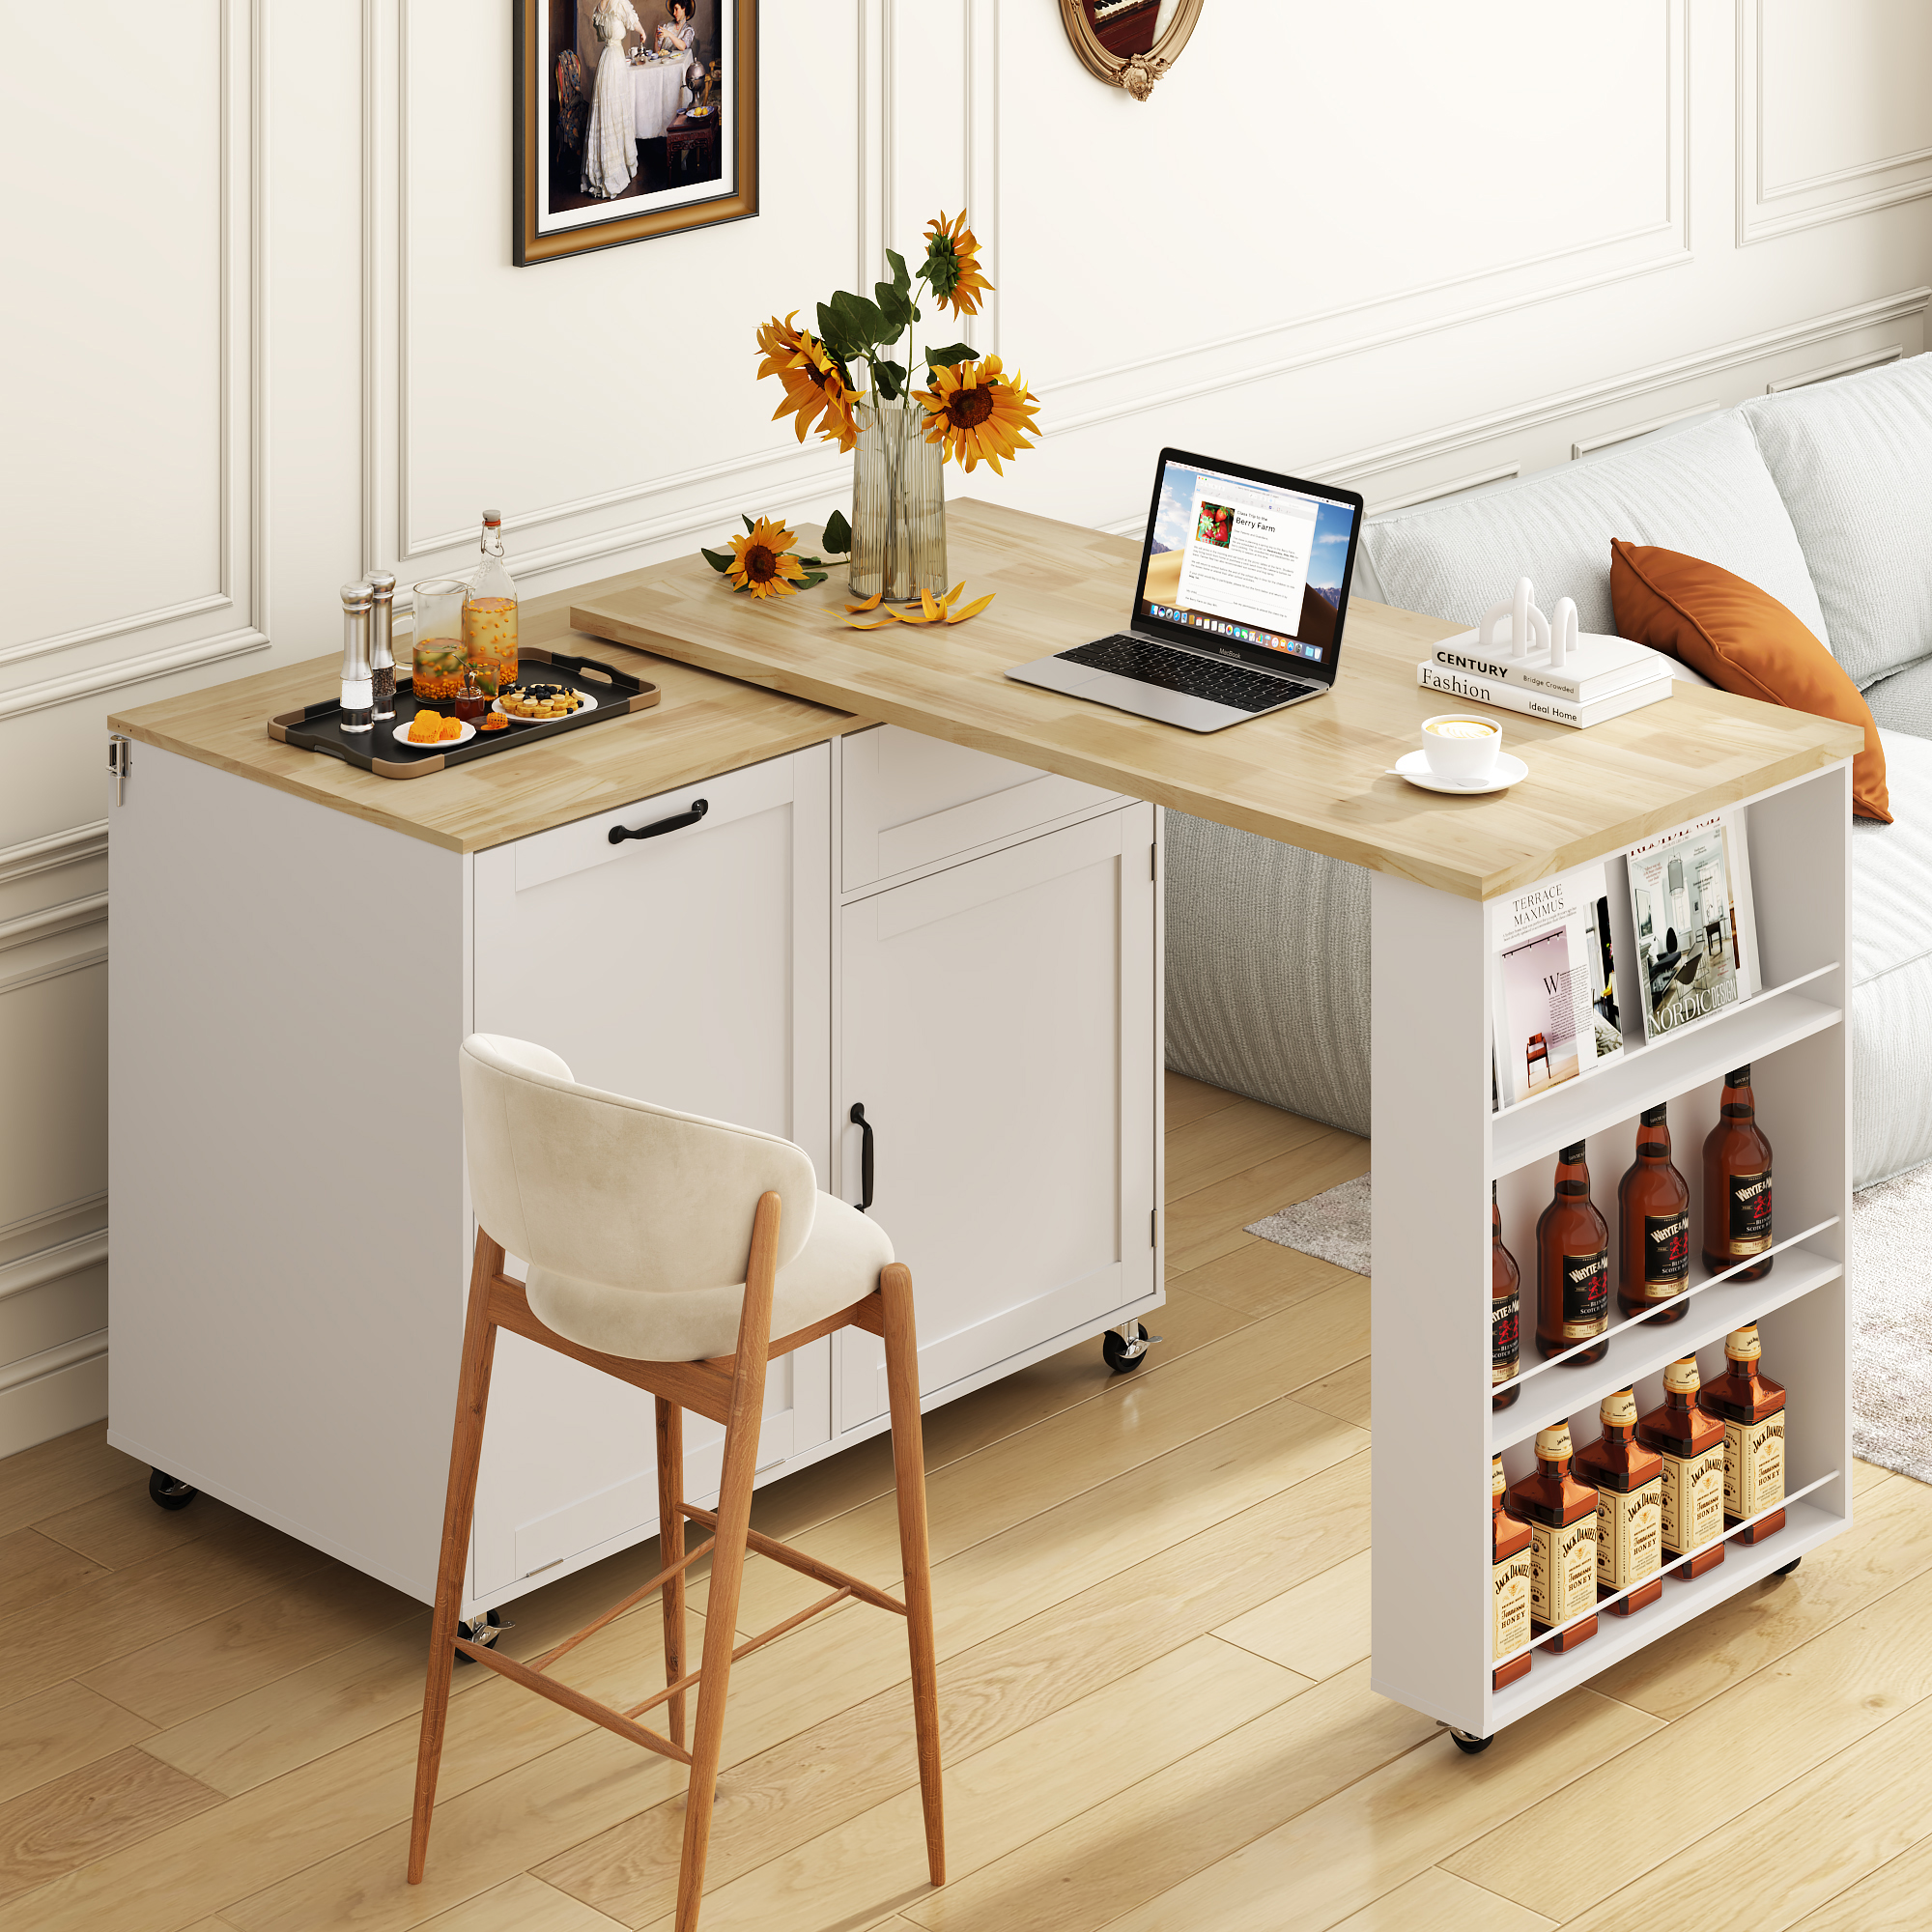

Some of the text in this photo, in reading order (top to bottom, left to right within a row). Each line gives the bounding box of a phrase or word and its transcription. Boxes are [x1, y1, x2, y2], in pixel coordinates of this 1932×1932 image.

[1236, 517, 1275, 533] Berry Farm
[1219, 647, 1240, 659] MacBook
[1436, 651, 1508, 678] CENTURY
[1422, 668, 1491, 701] Fashion
[1522, 675, 1575, 694] Bridge Crowded
[1528, 701, 1577, 722] Ideal Home
[1513, 884, 1563, 912] TERRACE
[1515, 898, 1564, 927] MAXIMUS
[1648, 989, 1711, 1037] NORDIC
[1711, 978, 1737, 1009] DESIGN
[1735, 1181, 1763, 1202] WHYTE
[1650, 1223, 1679, 1243] WHYTE
[1569, 1263, 1598, 1283] WHYTE
[1753, 1432, 1766, 1454] JACK
[1690, 1467, 1704, 1488] JACK
[1758, 1469, 1779, 1486] HONEY
[1628, 1499, 1641, 1522] JACK
[1697, 1503, 1719, 1520] HONEY
[1562, 1536, 1577, 1558] JACK
[1634, 1538, 1657, 1555] HONEY
[1495, 1573, 1510, 1595] JACK
[1568, 1574, 1592, 1592] HONEY
[1501, 1610, 1525, 1629] HONEY
